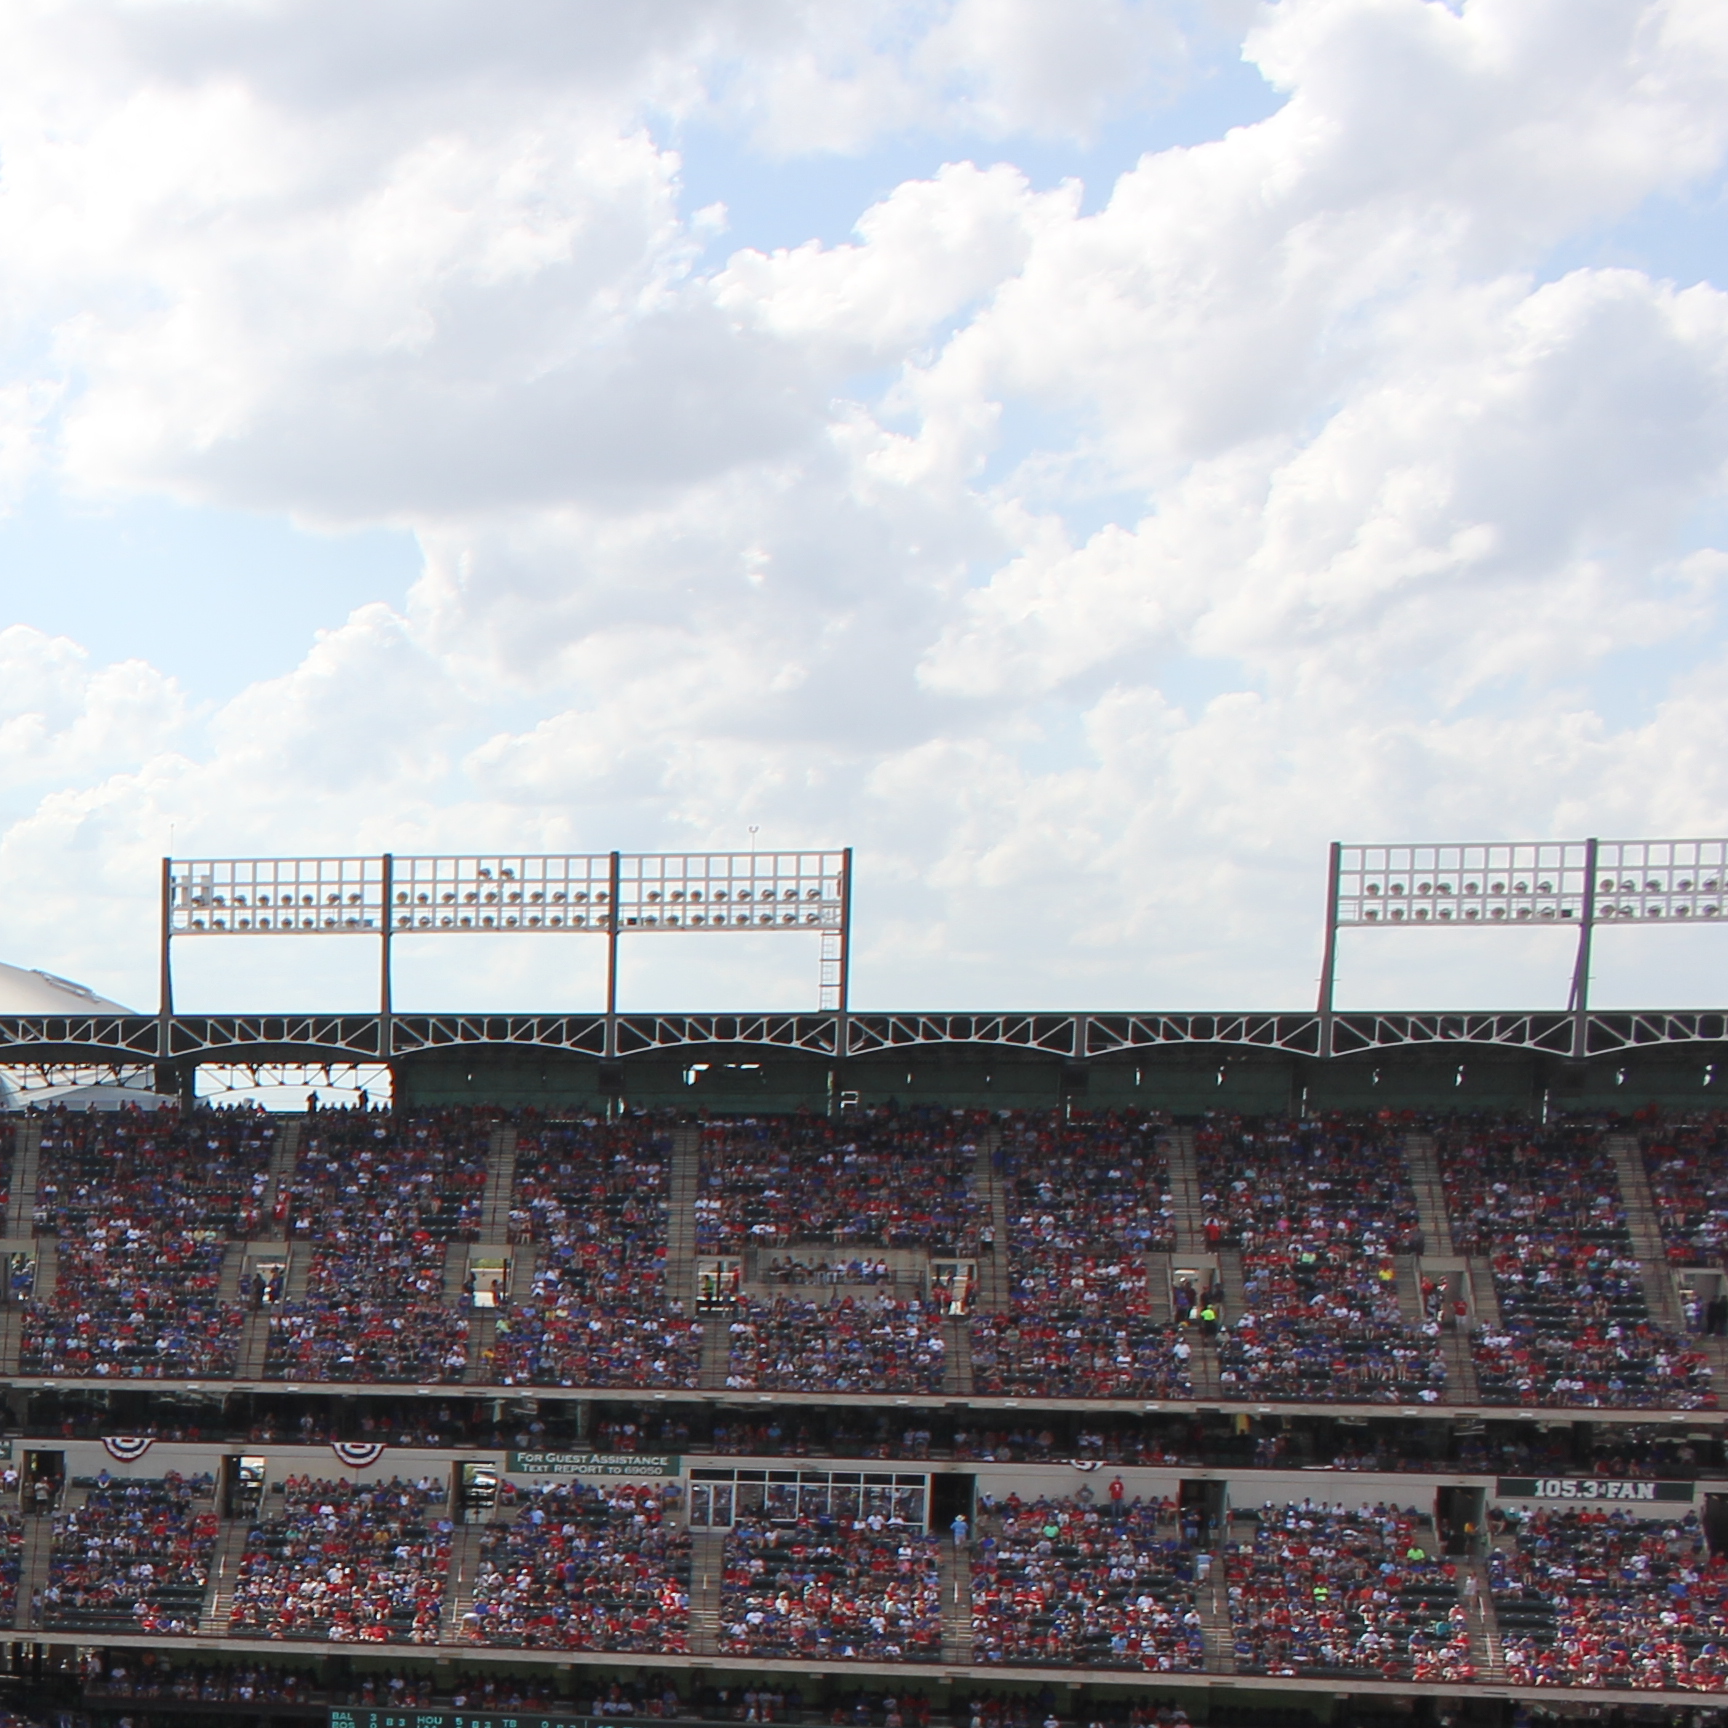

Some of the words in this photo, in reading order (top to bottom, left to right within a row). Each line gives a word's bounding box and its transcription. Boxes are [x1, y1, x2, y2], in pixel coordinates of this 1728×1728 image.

[517, 1453, 542, 1462] FOR
[546, 1453, 585, 1463] GUEST
[590, 1454, 667, 1465] ASSISTANCE
[523, 1464, 548, 1472] TEXT
[554, 1465, 602, 1473] REPORT
[1535, 1480, 1597, 1498] 105.3
[1606, 1482, 1653, 1499] FAN
